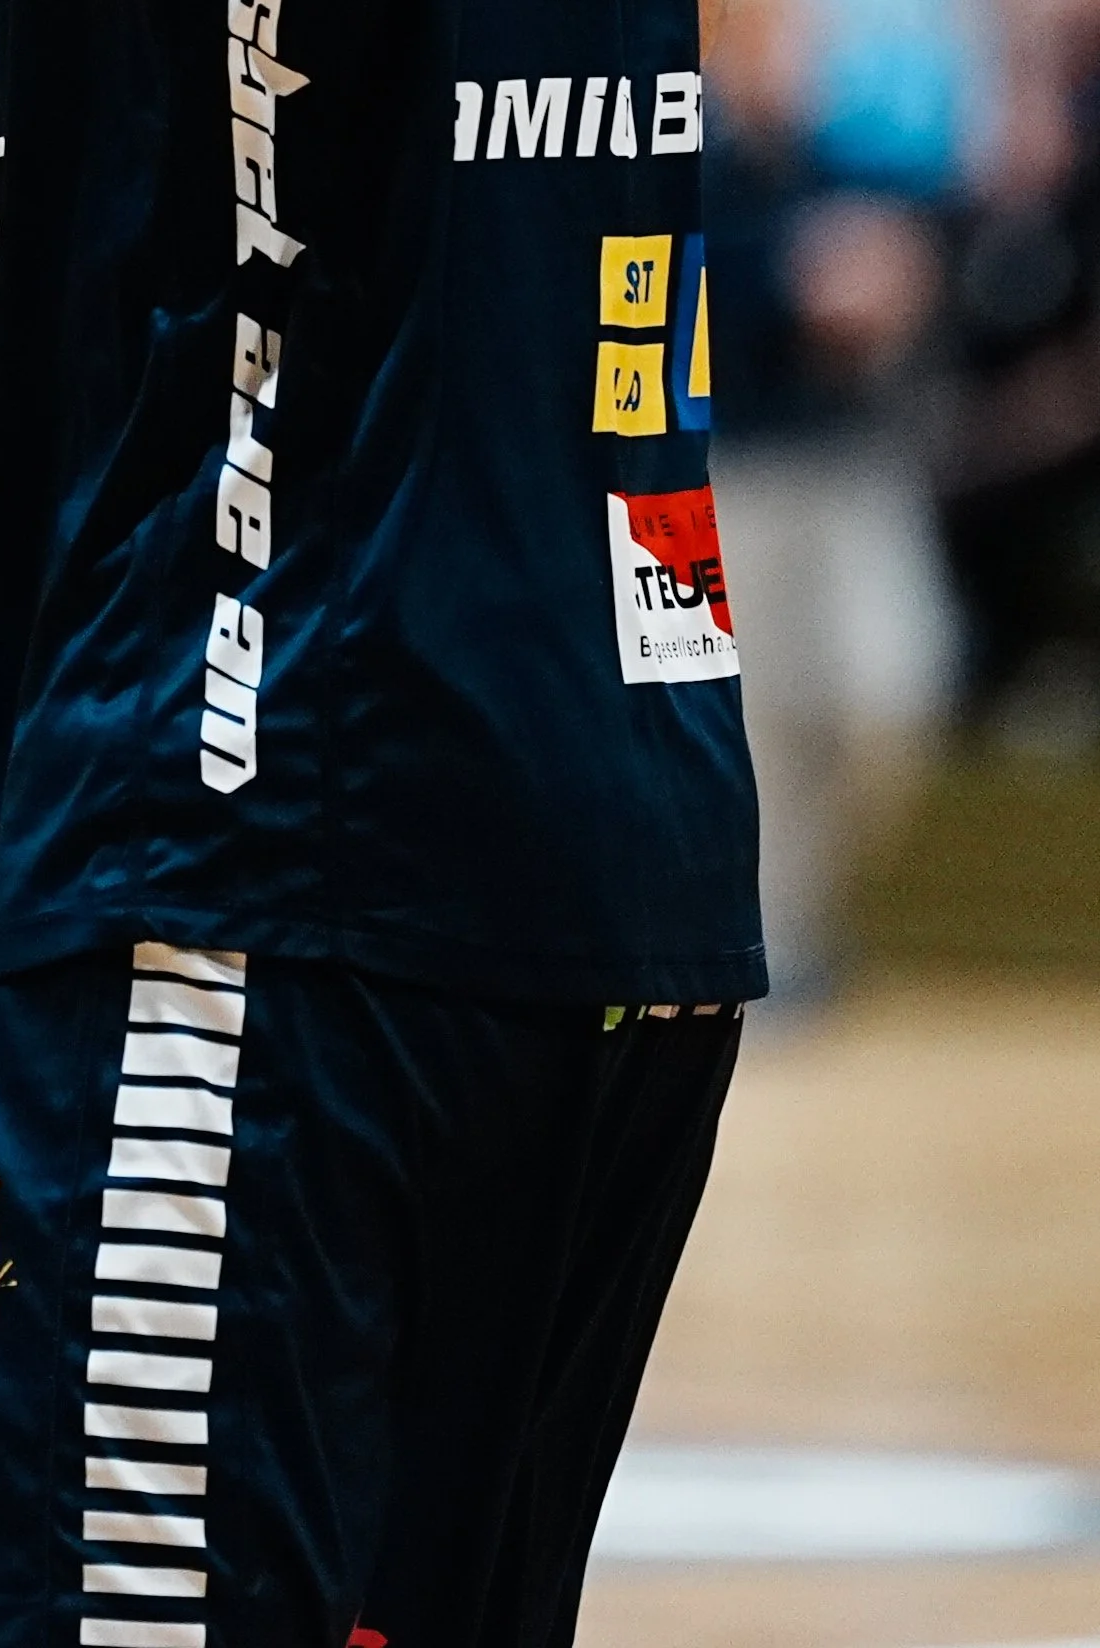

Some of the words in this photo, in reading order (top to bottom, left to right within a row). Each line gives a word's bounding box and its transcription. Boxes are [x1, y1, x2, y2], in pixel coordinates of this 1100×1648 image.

[215, 312, 282, 571] are
[635, 557, 727, 611] TEUE
[199, 591, 264, 794] we
